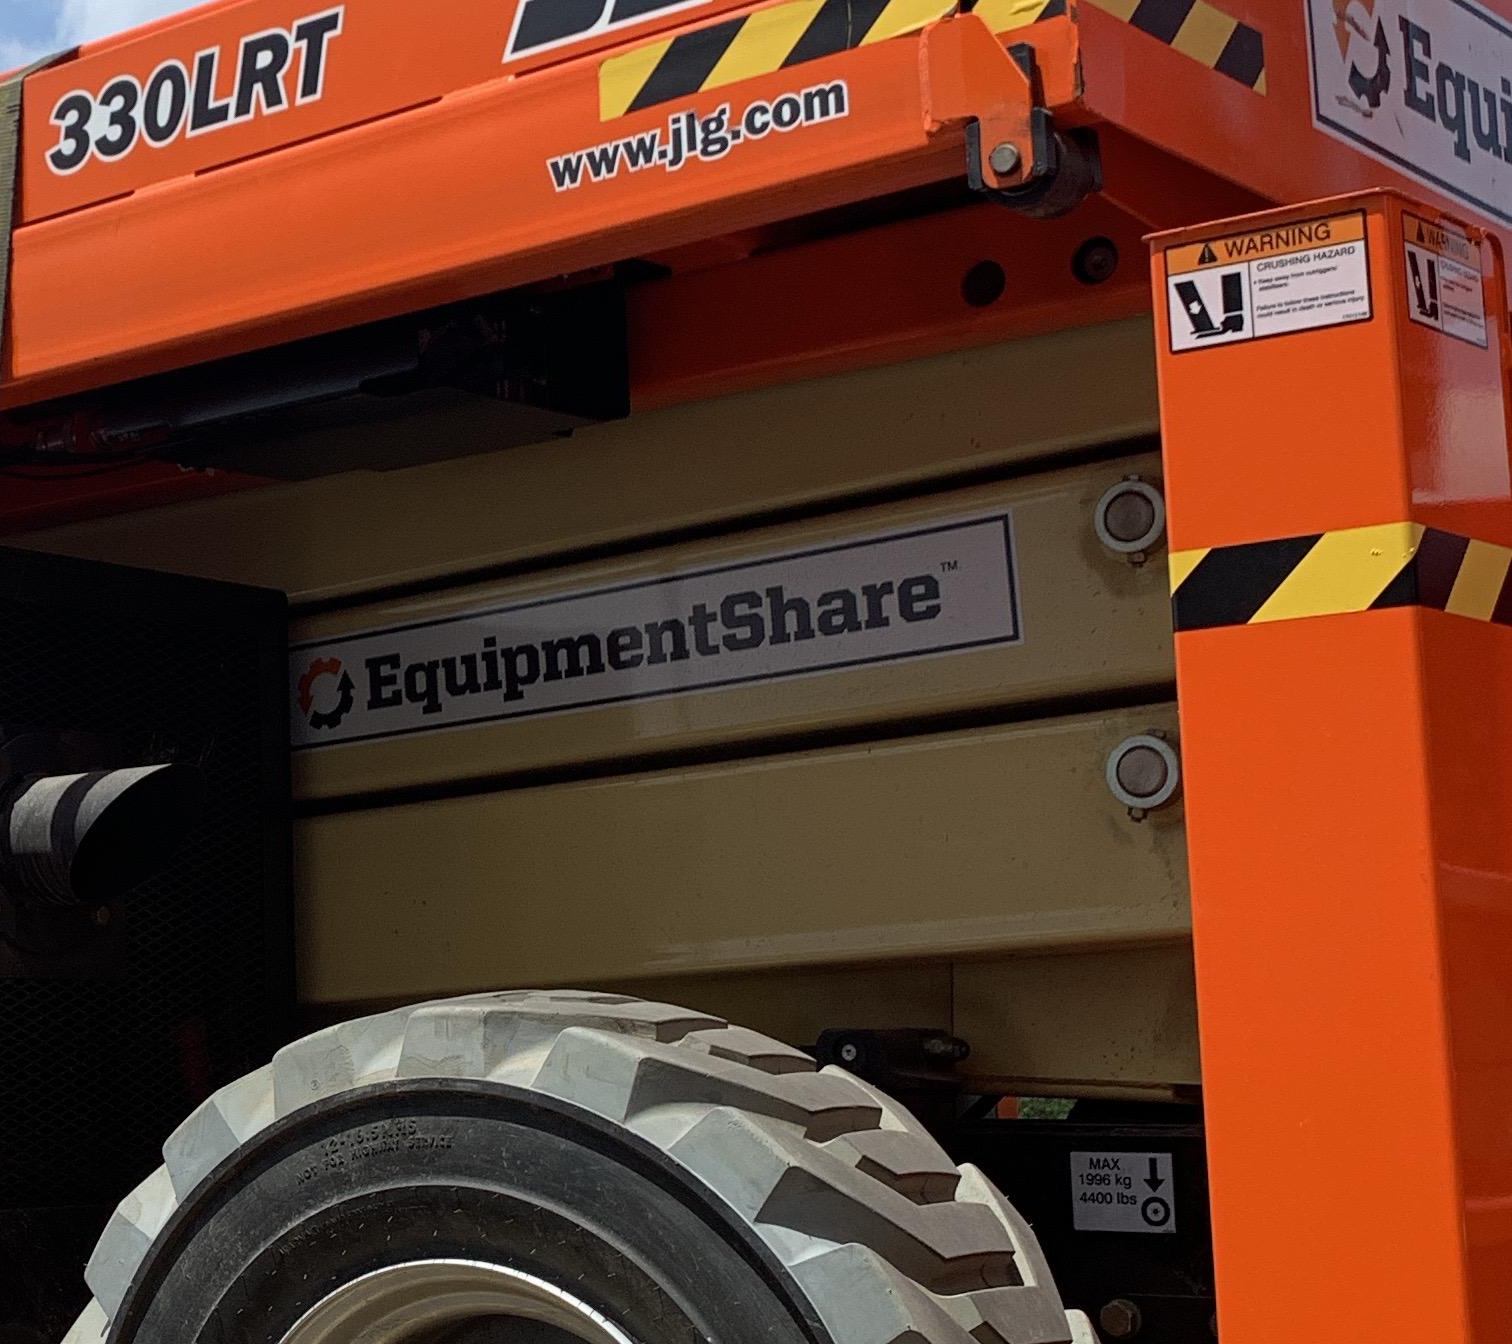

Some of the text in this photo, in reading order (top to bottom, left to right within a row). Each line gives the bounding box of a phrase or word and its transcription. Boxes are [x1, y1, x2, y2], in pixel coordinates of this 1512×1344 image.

[45, 6, 345, 176] 330LRT
[547, 79, 849, 192] www.jlg.com
[1225, 223, 1331, 258] WARNING
[1256, 245, 1356, 273] CRUSHING HAZARD
[365, 571, 942, 716] EquipmentShare
[295, 1166, 318, 1186] NOT
[1089, 1157, 1120, 1171] MAX
[1079, 1173, 1132, 1190] 1996 kg
[1079, 1191, 1138, 1205] 4400 lbs
